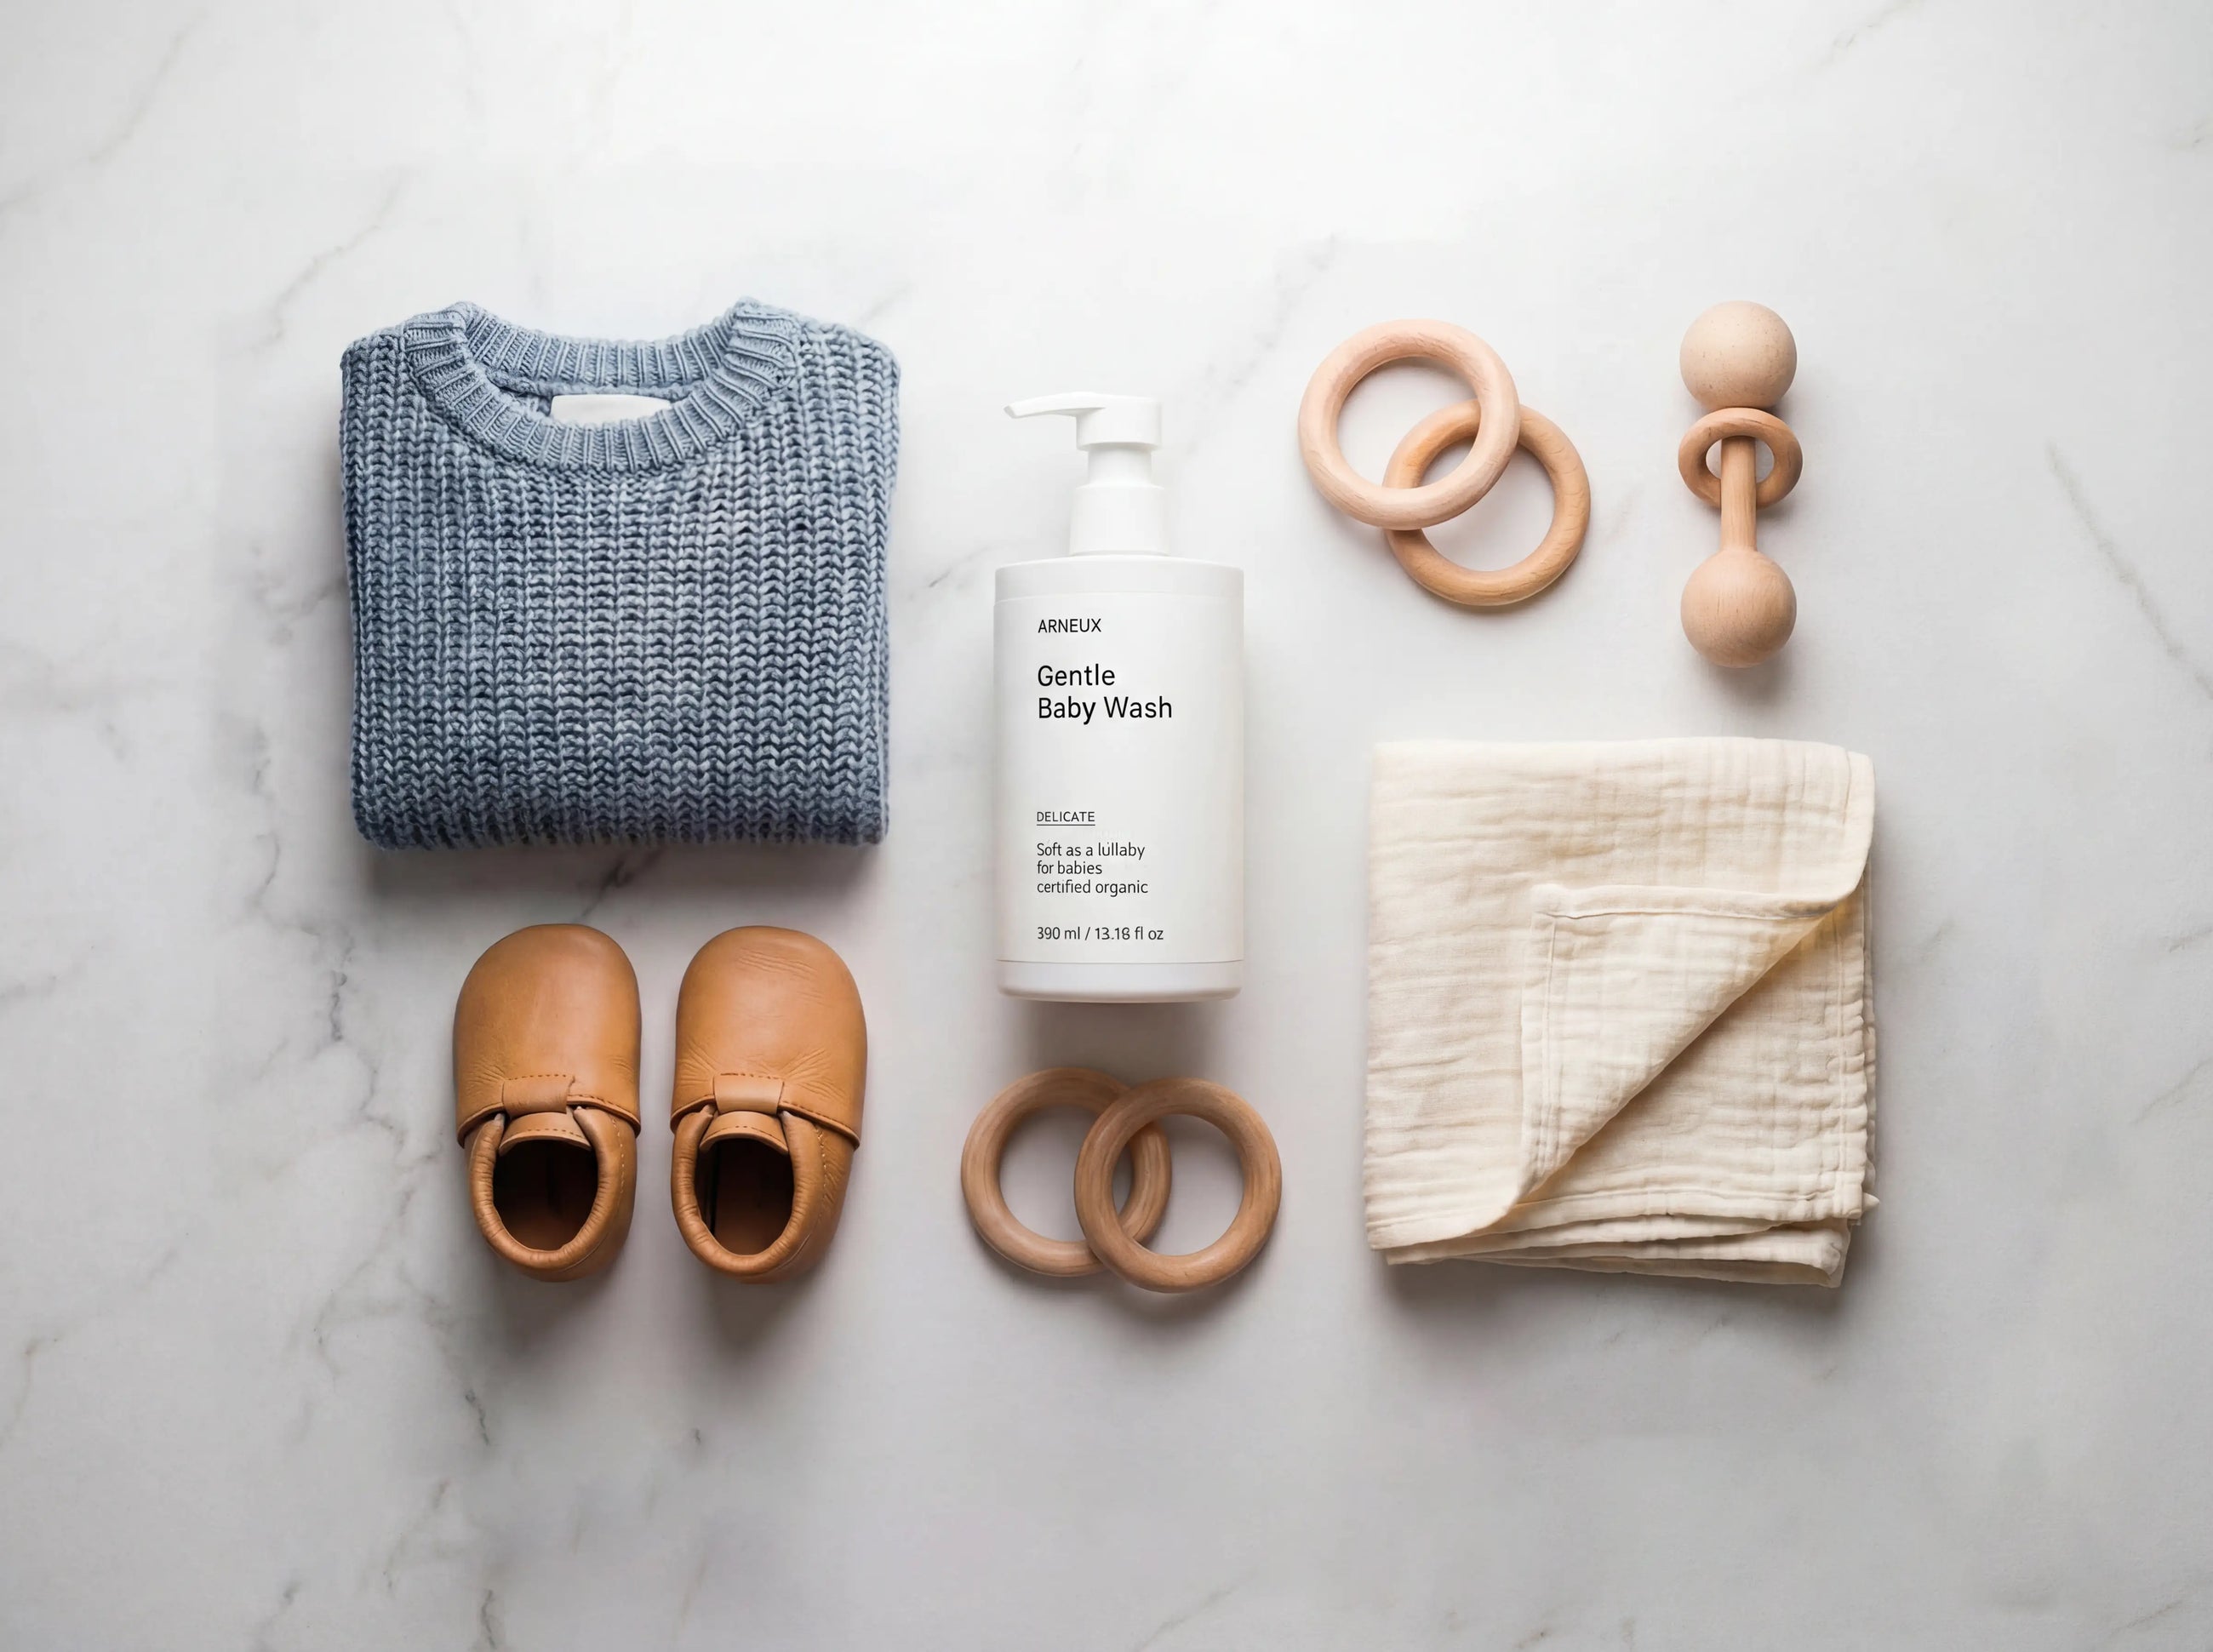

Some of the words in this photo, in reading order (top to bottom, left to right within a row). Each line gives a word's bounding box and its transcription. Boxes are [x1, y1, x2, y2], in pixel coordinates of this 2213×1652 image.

[1038, 618, 1102, 634] ARNEUX
[1038, 663, 1116, 687] Gentle
[1038, 695, 1096, 725] Baby
[1104, 695, 1172, 719] Wash
[1036, 811, 1095, 822] DELICATE
[1037, 842, 1062, 857] Soft
[1066, 846, 1082, 857] as
[1085, 846, 1094, 857] a
[1098, 842, 1146, 860] lullaby
[1037, 860, 1055, 874] for
[1057, 860, 1102, 875] babies
[1037, 879, 1091, 894] certified
[1095, 880, 1149, 897] organic
[1037, 926, 1061, 940] 390
[1064, 926, 1081, 940] ml
[1084, 926, 1091, 941] /
[1134, 926, 1144, 940] fl
[1147, 929, 1164, 940] oz
